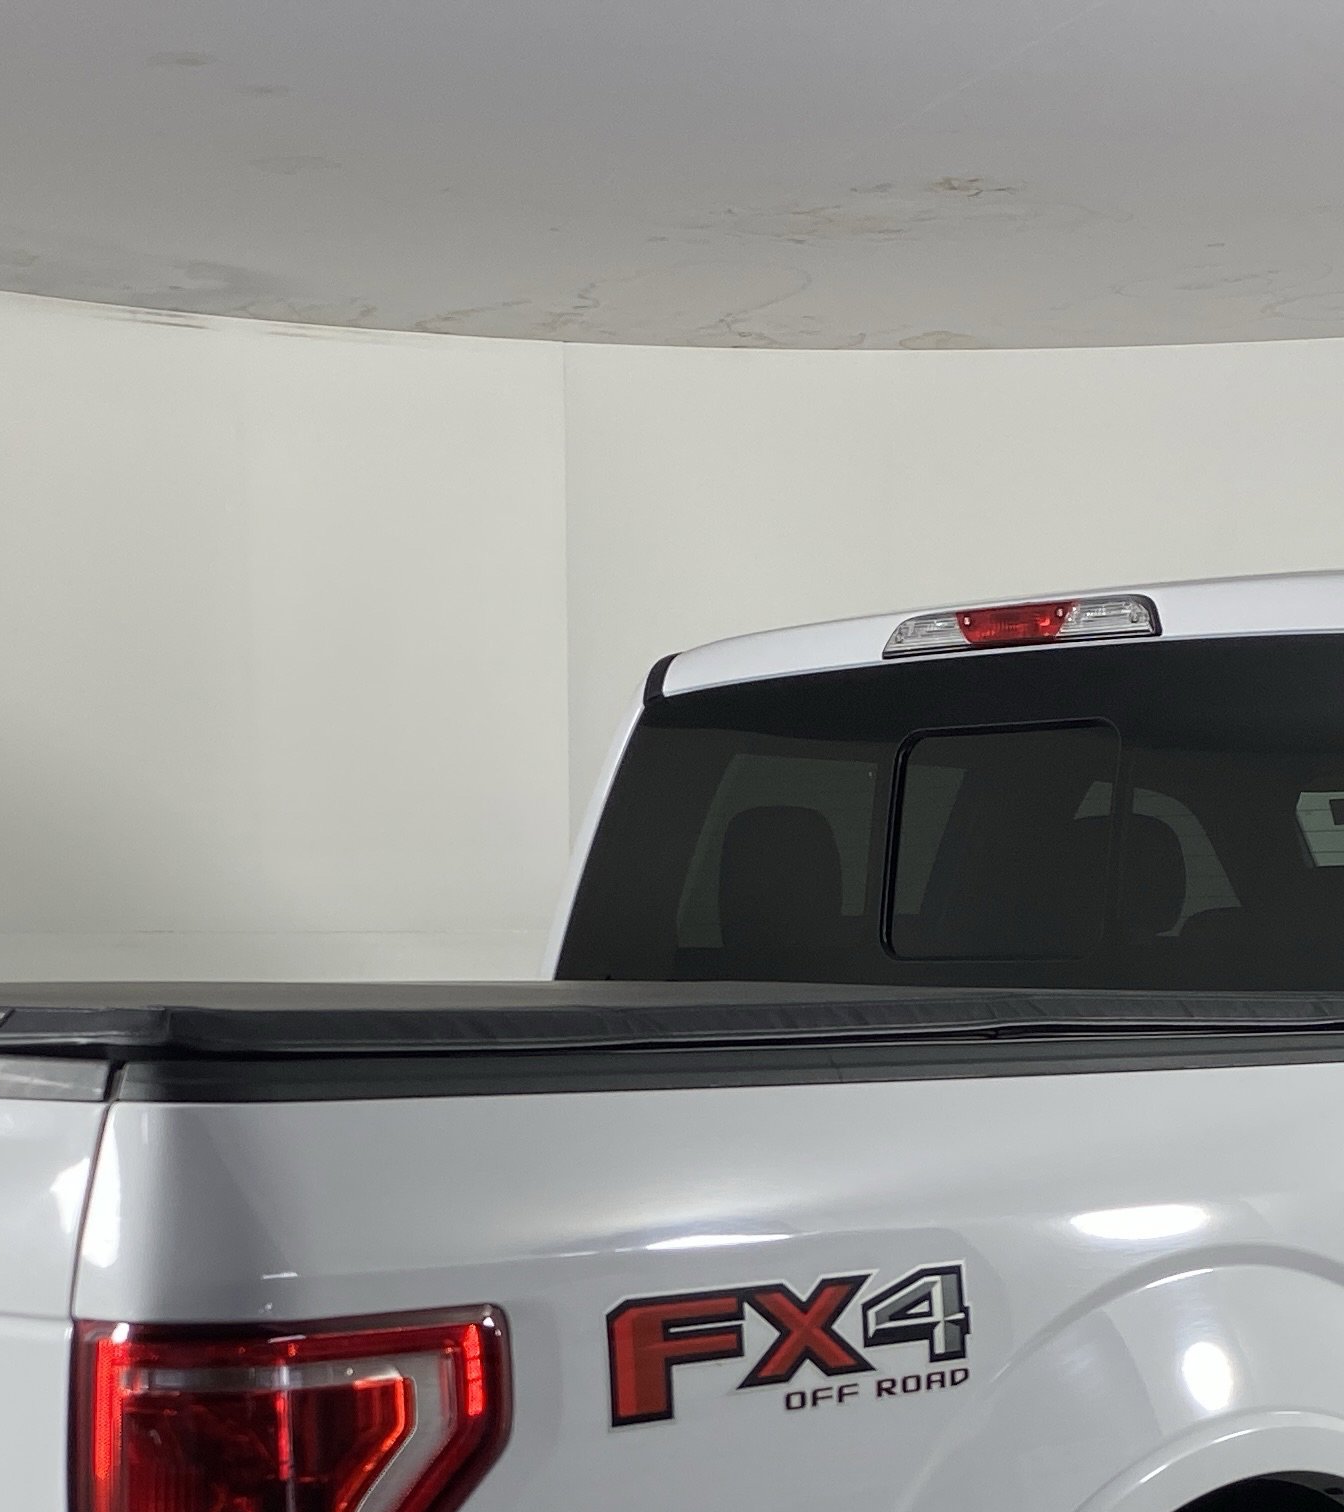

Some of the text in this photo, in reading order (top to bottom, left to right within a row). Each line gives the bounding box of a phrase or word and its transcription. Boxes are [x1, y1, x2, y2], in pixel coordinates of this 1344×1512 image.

[606, 1260, 971, 1428] FX4
[784, 1367, 970, 1412] OFF ROAD
